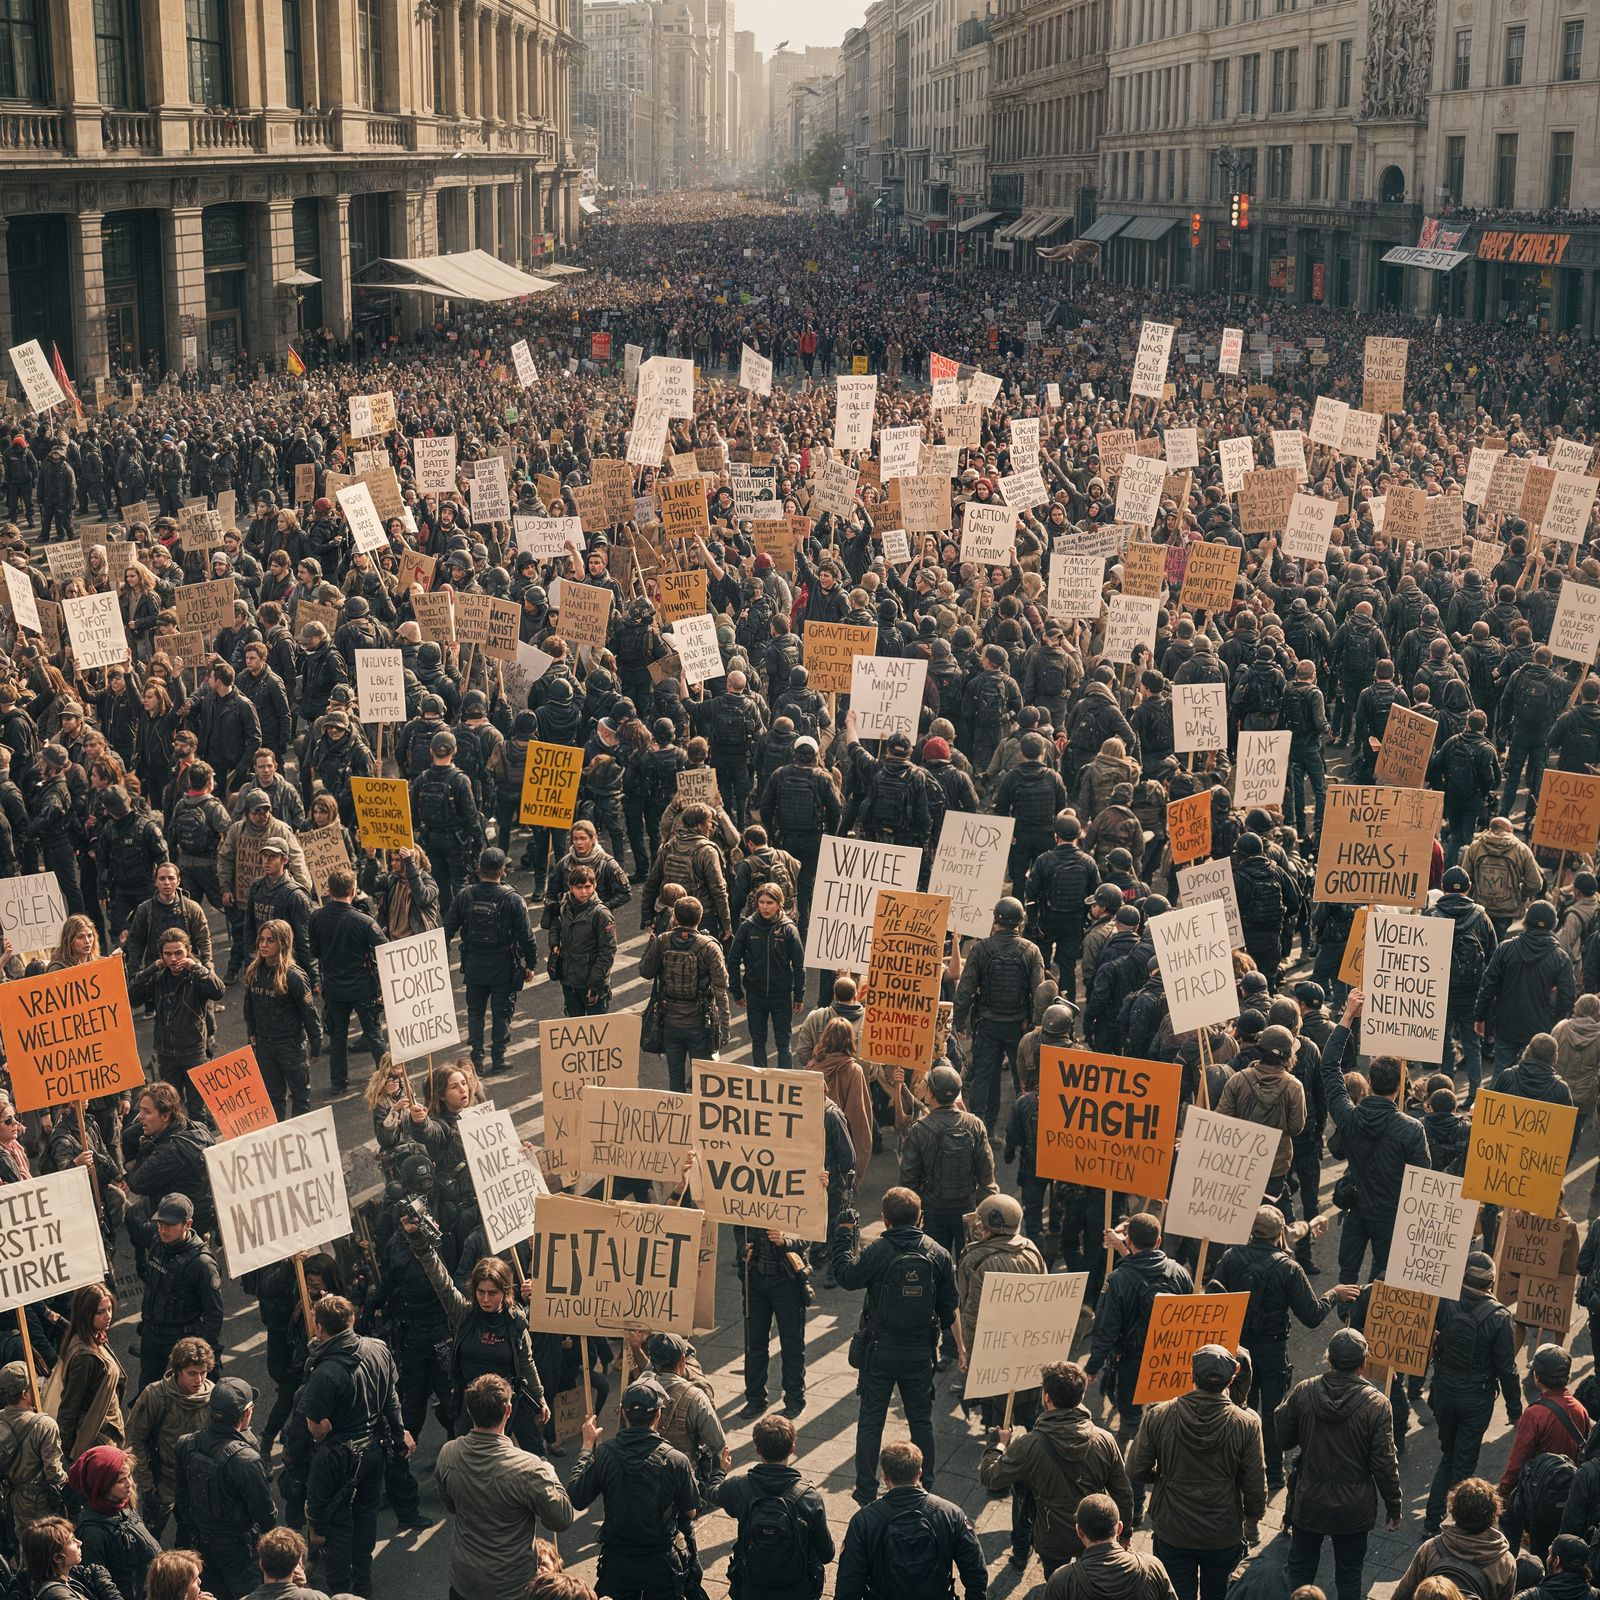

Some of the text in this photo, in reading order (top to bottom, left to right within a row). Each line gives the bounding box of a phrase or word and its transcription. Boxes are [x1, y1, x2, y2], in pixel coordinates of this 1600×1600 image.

[535, 747, 572, 768] STICH
[386, 939, 438, 974] TTOUR
[1374, 975, 1391, 989] OF
[412, 998, 434, 1017] OFF
[700, 1074, 802, 1106] DELLIE
[1526, 1234, 1548, 1247] YOU
[1149, 1356, 1170, 1369] ON
